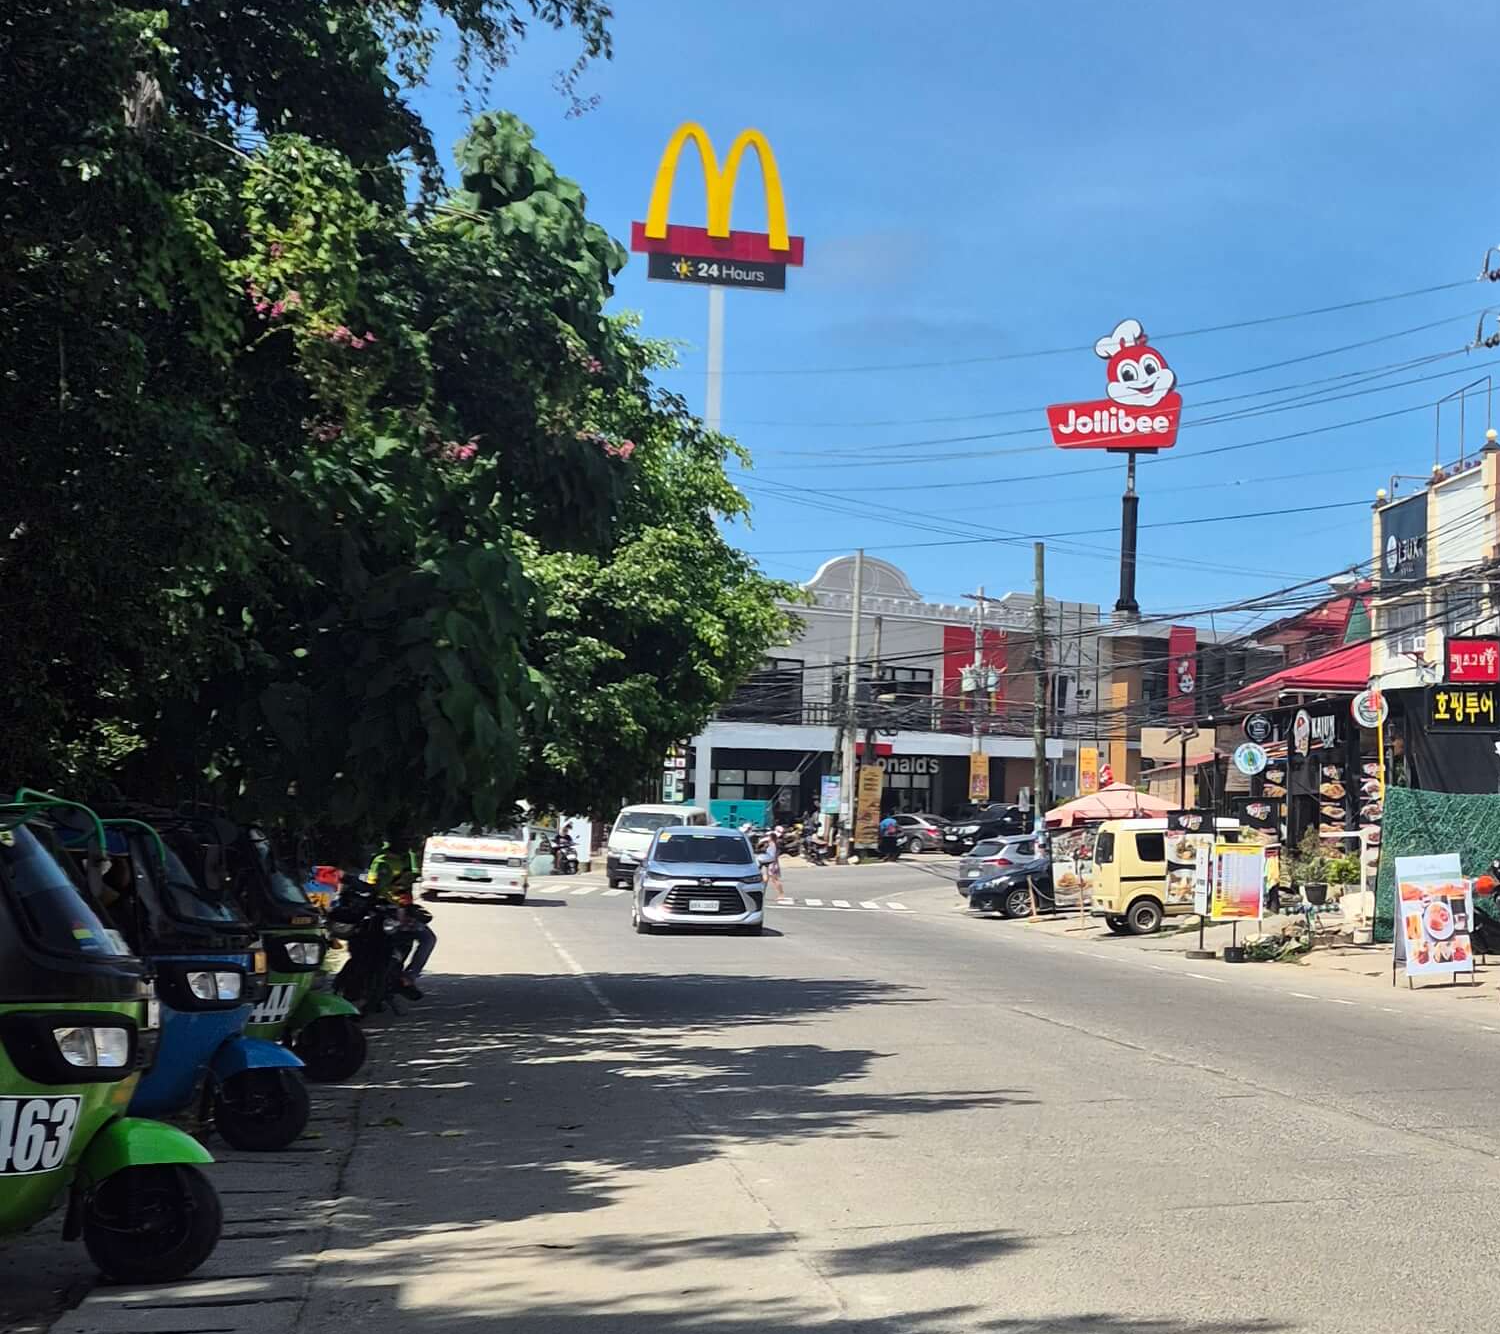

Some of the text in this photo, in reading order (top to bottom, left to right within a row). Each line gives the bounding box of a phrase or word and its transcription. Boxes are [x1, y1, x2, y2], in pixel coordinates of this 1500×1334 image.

[697, 262, 765, 282] 24 Hours
[1058, 407, 1170, 434] Jollibee
[1434, 691, 1494, 723] 호핑투어
[855, 756, 940, 774] onald's
